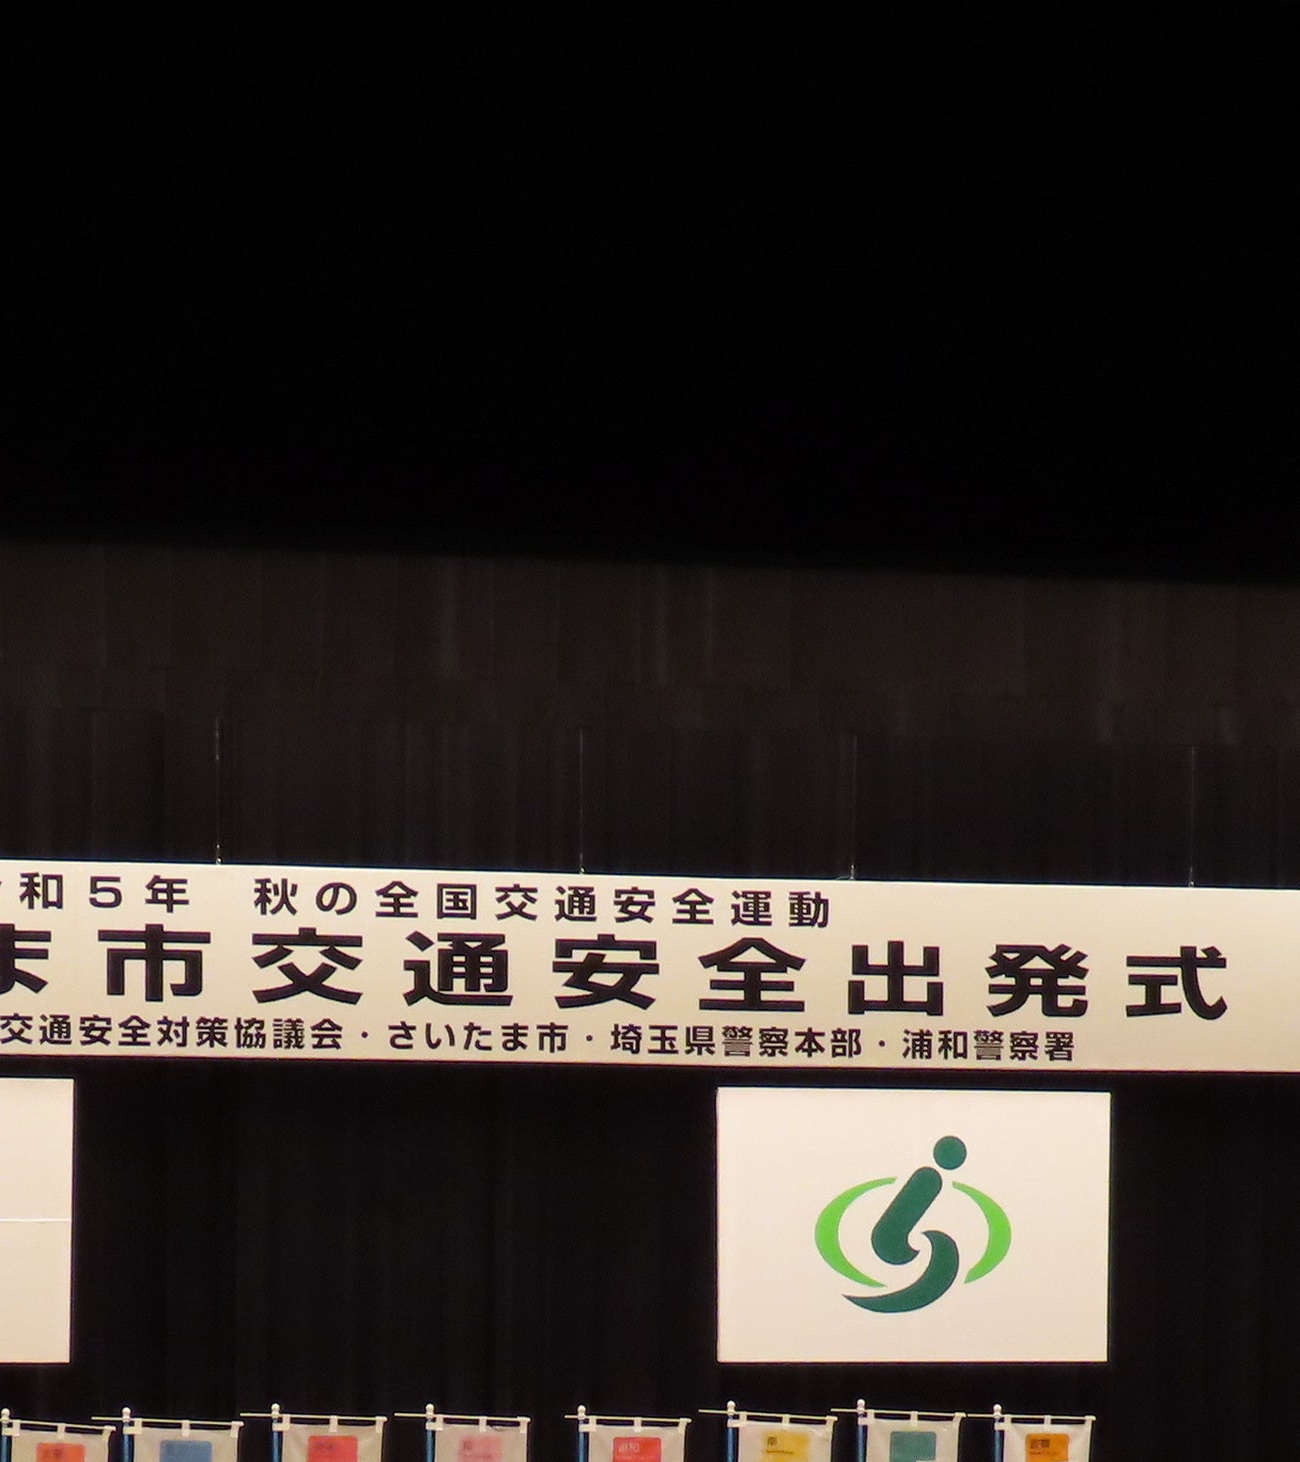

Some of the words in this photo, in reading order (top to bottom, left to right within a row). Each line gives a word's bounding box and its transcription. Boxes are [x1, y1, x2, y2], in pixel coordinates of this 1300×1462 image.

[253, 876, 831, 928] 秋の全国交通安全運動
